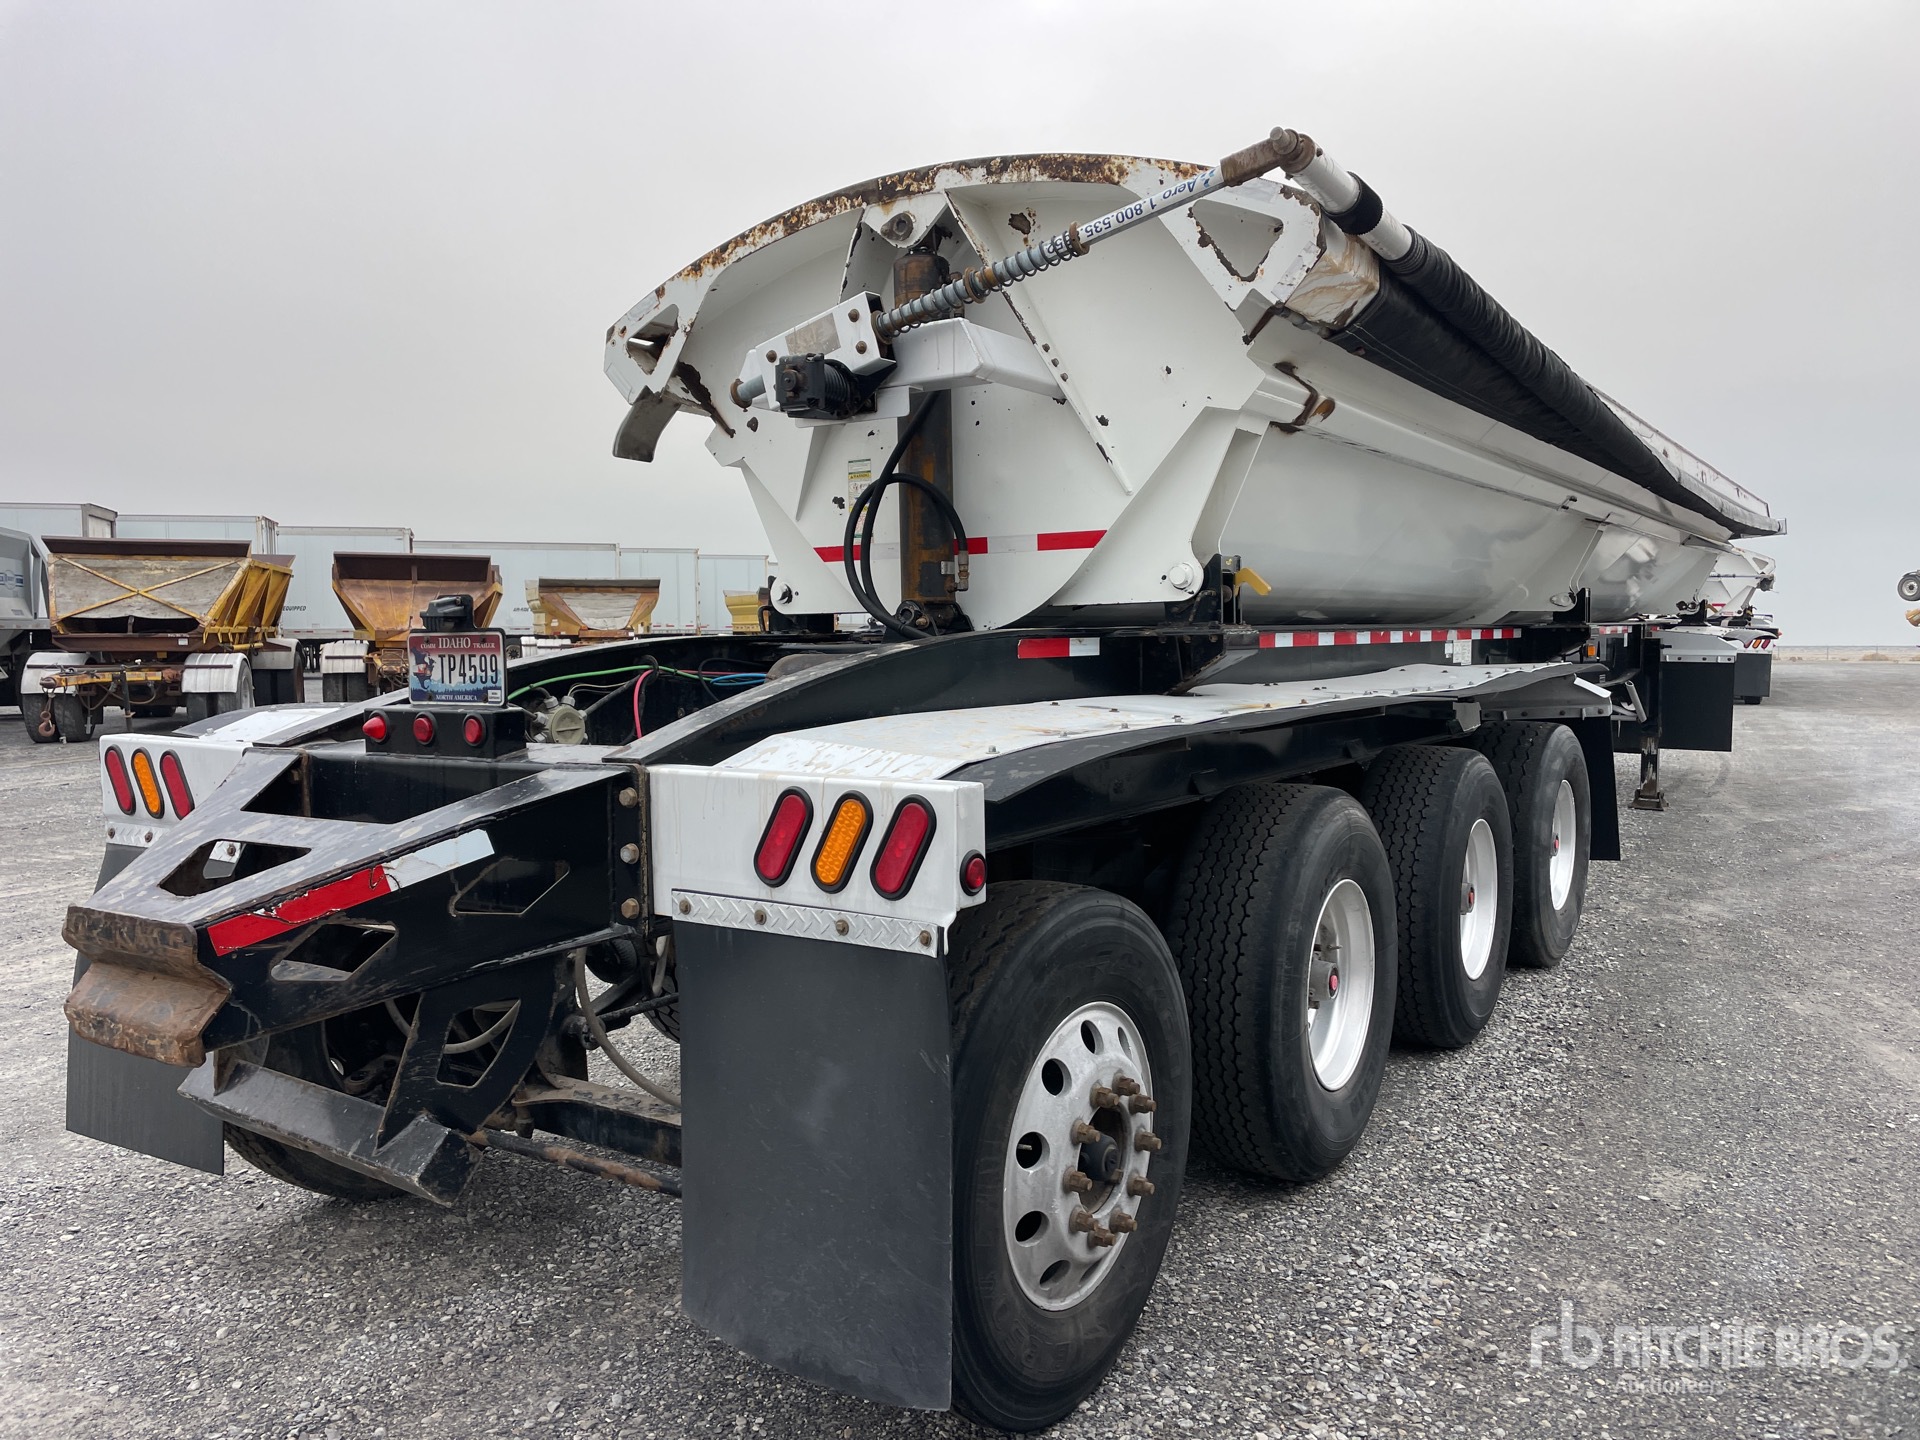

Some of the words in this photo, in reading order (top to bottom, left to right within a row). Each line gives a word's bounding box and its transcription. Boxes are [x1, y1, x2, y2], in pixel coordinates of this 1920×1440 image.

[1163, 178, 1197, 200] Aero
[438, 637, 471, 649] IDAHO
[438, 654, 499, 684] TP4599
